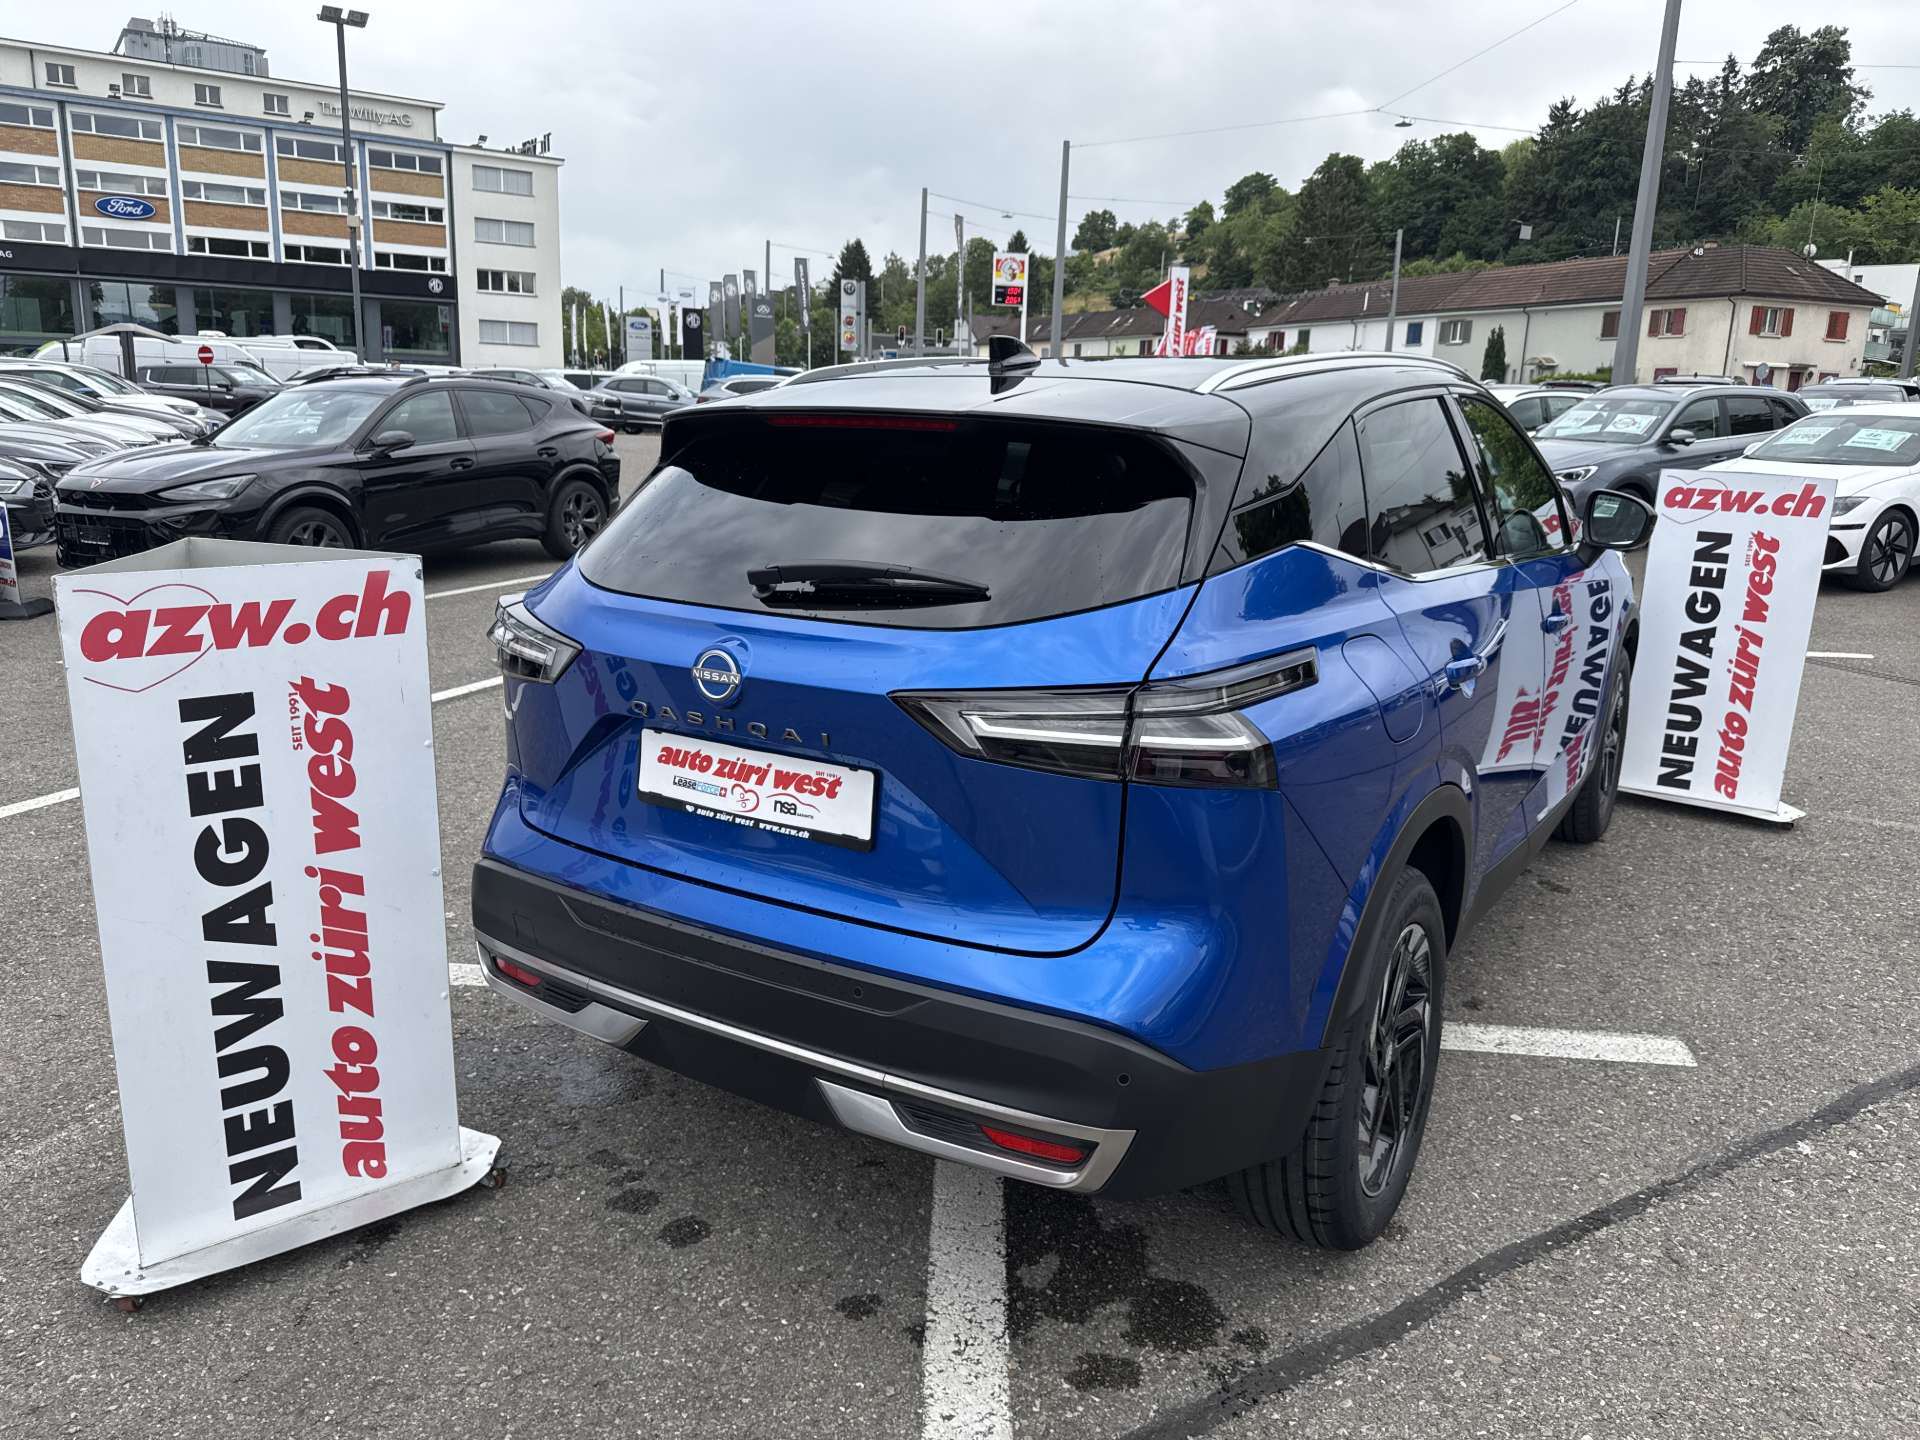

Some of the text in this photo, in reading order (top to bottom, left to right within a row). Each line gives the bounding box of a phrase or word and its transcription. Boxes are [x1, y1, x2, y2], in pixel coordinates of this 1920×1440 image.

[348, 105, 385, 126] Willy
[388, 112, 413, 128] AG
[107, 199, 143, 216] Ford
[1664, 484, 1826, 518] azw.ch
[80, 570, 411, 662] azw.ch
[692, 669, 739, 684] NISSAN
[1657, 531, 1732, 790] NEUWAGEN
[1714, 530, 1780, 800] auto züri west
[288, 692, 303, 750] SEIT 1991
[631, 700, 830, 747] QASHQAI
[657, 746, 842, 799] auto züri west
[673, 775, 719, 797] LeaseForce
[696, 808, 810, 839] auto züri west www.azw.ch
[774, 800, 797, 816] nsa
[288, 675, 388, 1179] auto züri west
[178, 692, 302, 1221] NEUWAGEN
